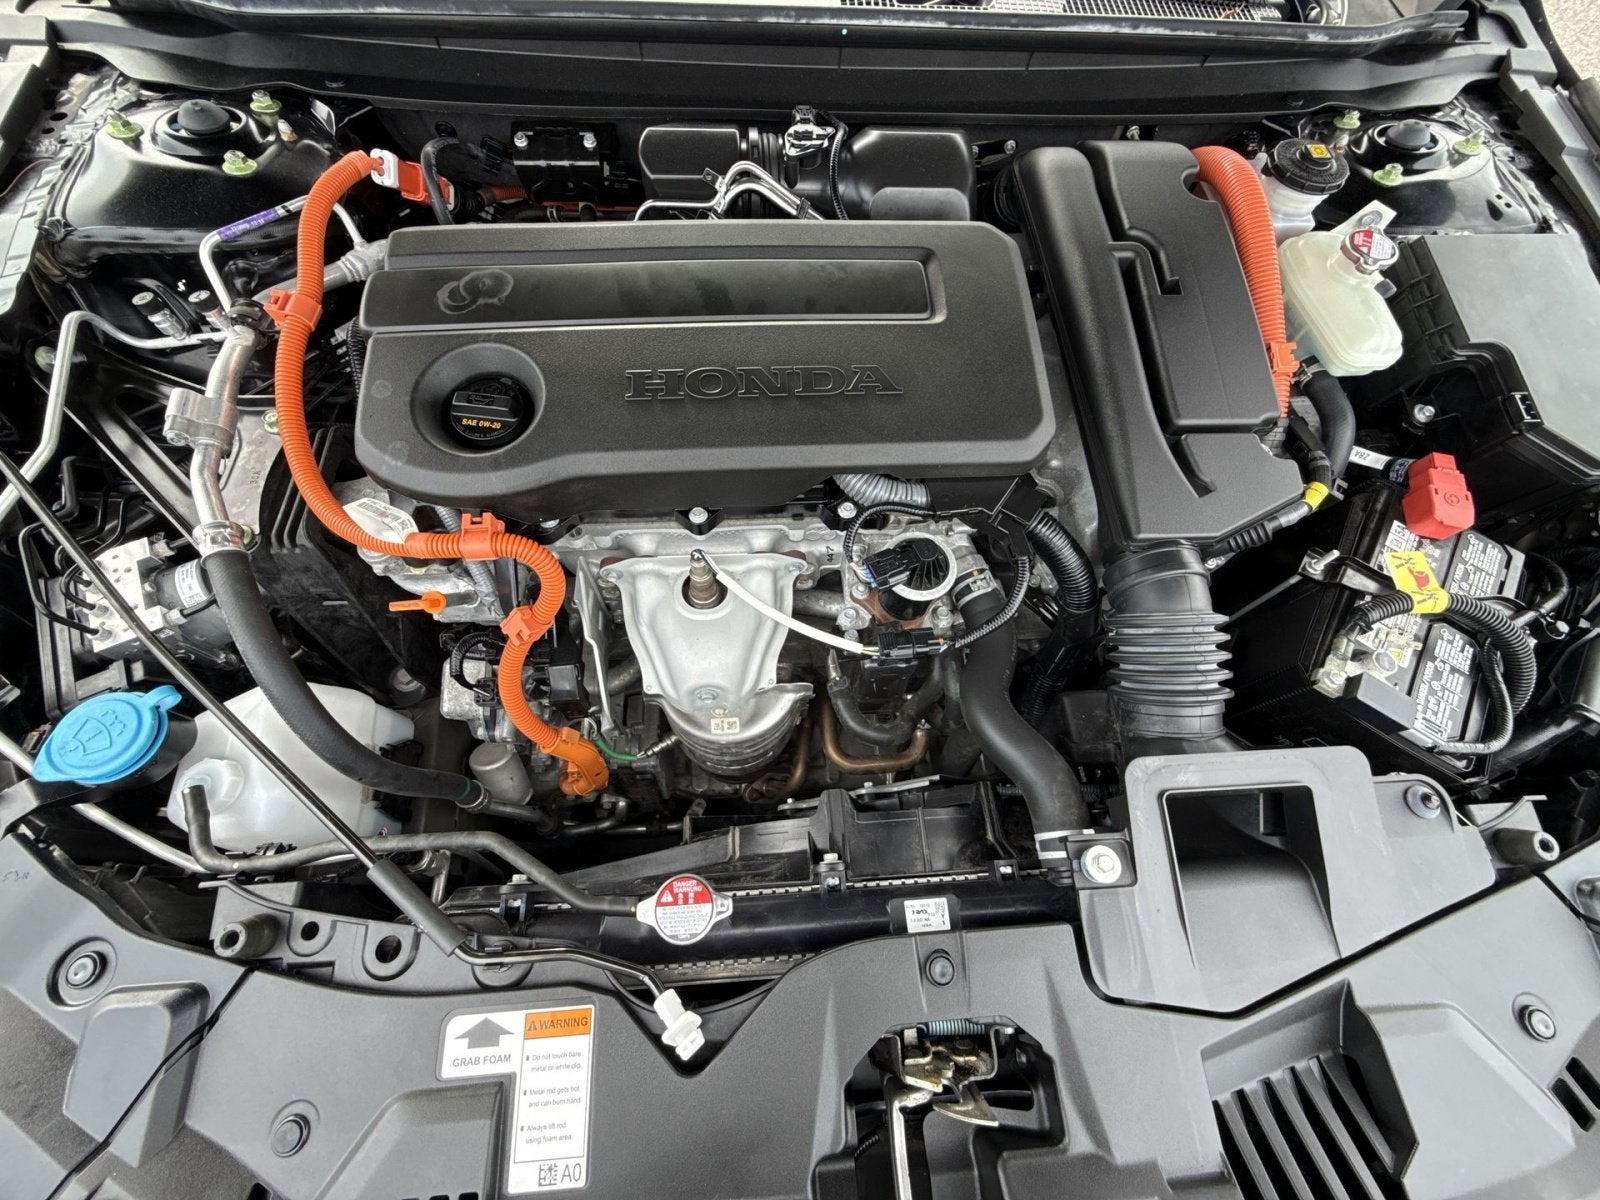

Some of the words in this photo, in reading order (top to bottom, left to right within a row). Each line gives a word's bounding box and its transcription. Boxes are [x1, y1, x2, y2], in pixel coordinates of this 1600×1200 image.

[625, 365, 903, 400] HONDA
[462, 418, 478, 427] SAE
[478, 420, 502, 430] 0W-20
[539, 1016, 589, 1031] WARNING
[452, 1057, 481, 1068] GRAB
[483, 1053, 512, 1065] FOAM
[531, 1065, 546, 1073] metal
[529, 1088, 545, 1096] Metal
[557, 1087, 569, 1095] gets
[526, 1124, 547, 1132] Always
[525, 1137, 541, 1145] using
[560, 1162, 582, 1183] A0
